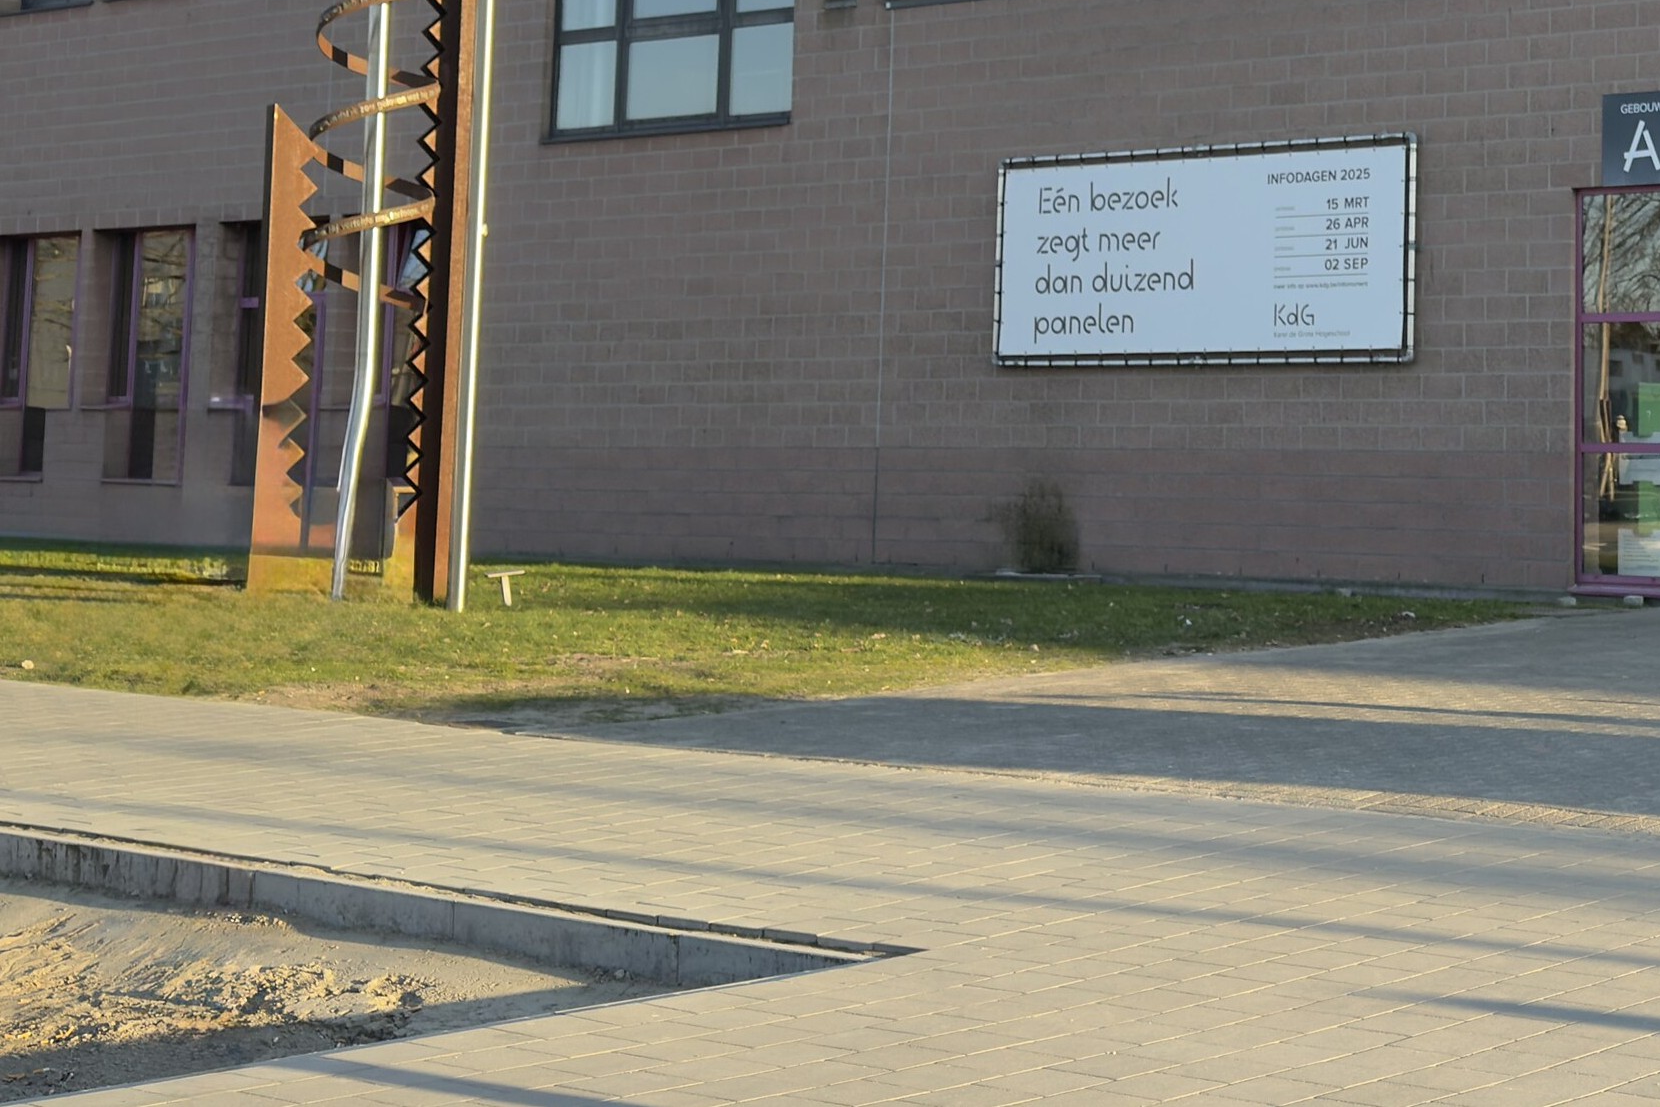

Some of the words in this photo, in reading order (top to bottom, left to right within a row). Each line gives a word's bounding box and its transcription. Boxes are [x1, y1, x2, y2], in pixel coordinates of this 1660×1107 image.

[1267, 169, 1337, 185] INFODAGEN
[1340, 167, 1371, 181] 2025
[1038, 187, 1080, 215] Eén
[1090, 176, 1179, 212] bezoek
[1326, 197, 1339, 211] 15
[1344, 196, 1370, 210] MRT
[1325, 217, 1341, 231] 26
[1344, 216, 1369, 229] APR
[1036, 227, 1090, 262] zegt
[1098, 230, 1161, 253] meer
[1325, 238, 1338, 251] 21
[1344, 236, 1369, 250] JUN
[1324, 258, 1340, 271] 02
[1343, 257, 1369, 270] SEP
[1035, 263, 1083, 295] dan
[1092, 258, 1195, 294] duizend
[1034, 302, 1135, 344] panelen
[1273, 303, 1315, 326] KdG
